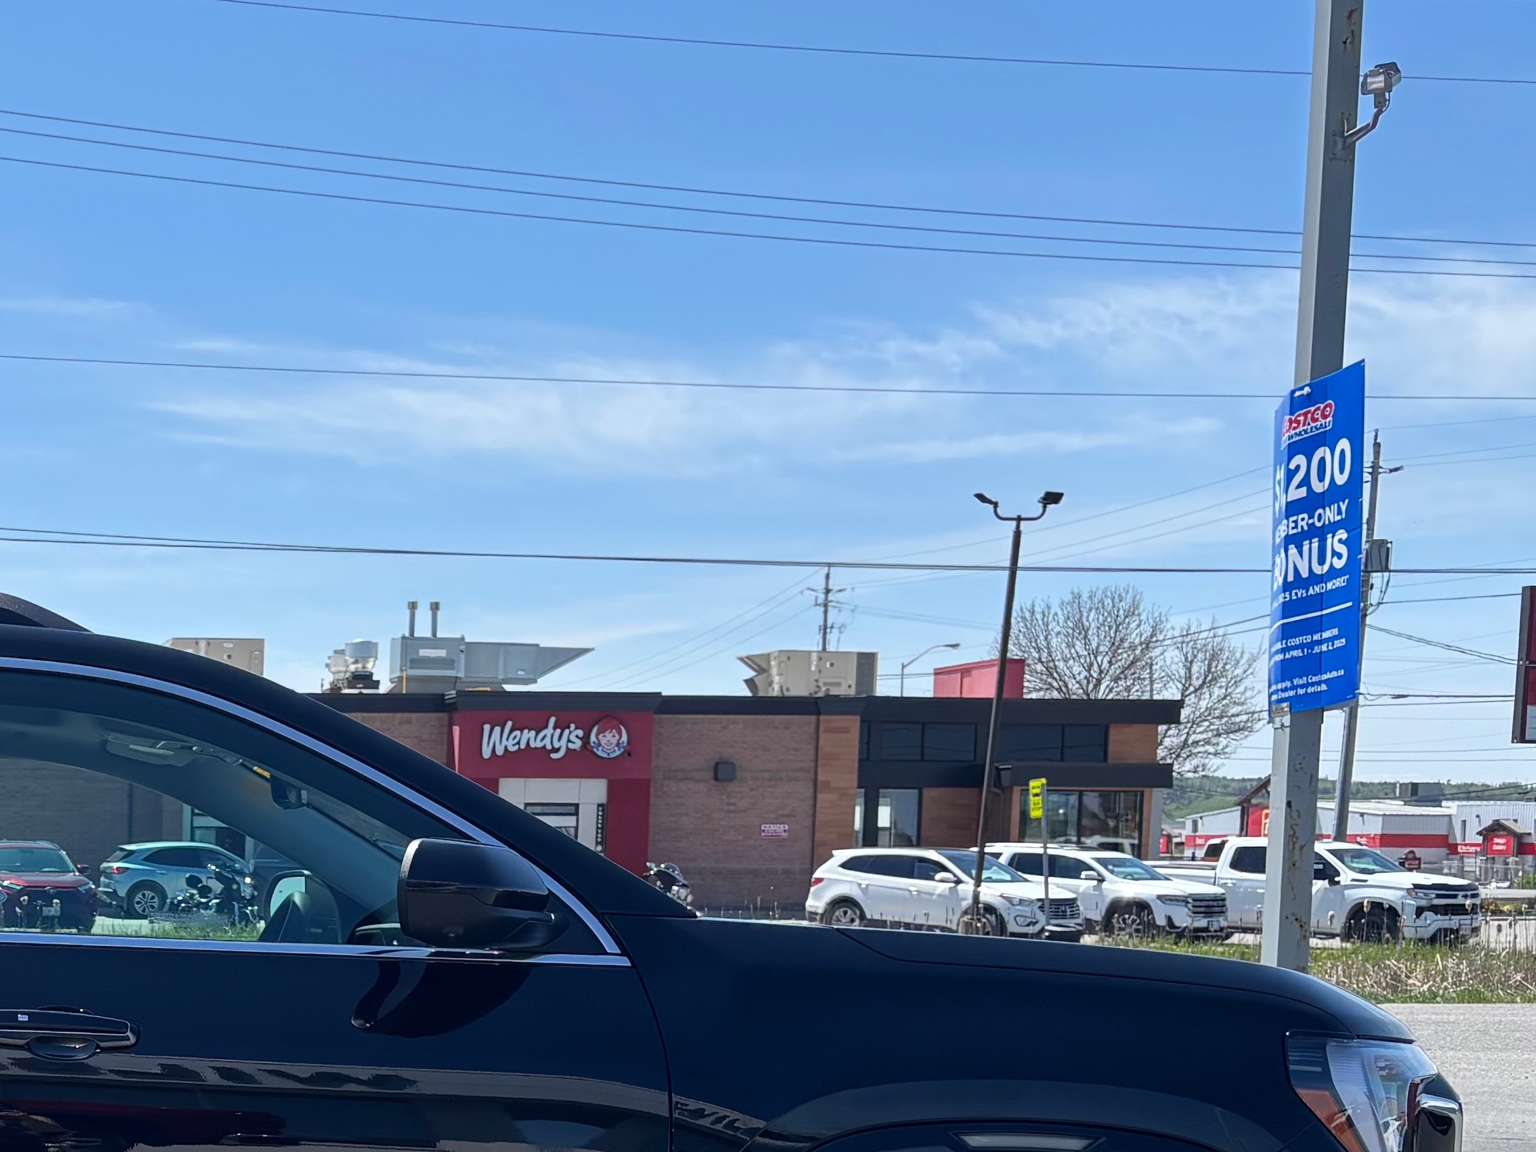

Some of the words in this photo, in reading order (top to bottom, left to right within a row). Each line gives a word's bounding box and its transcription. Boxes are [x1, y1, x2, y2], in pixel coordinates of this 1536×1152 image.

[1308, 583, 1326, 596] AND
[1287, 634, 1312, 646] COSTCO
[480, 716, 584, 760] Wendy's
